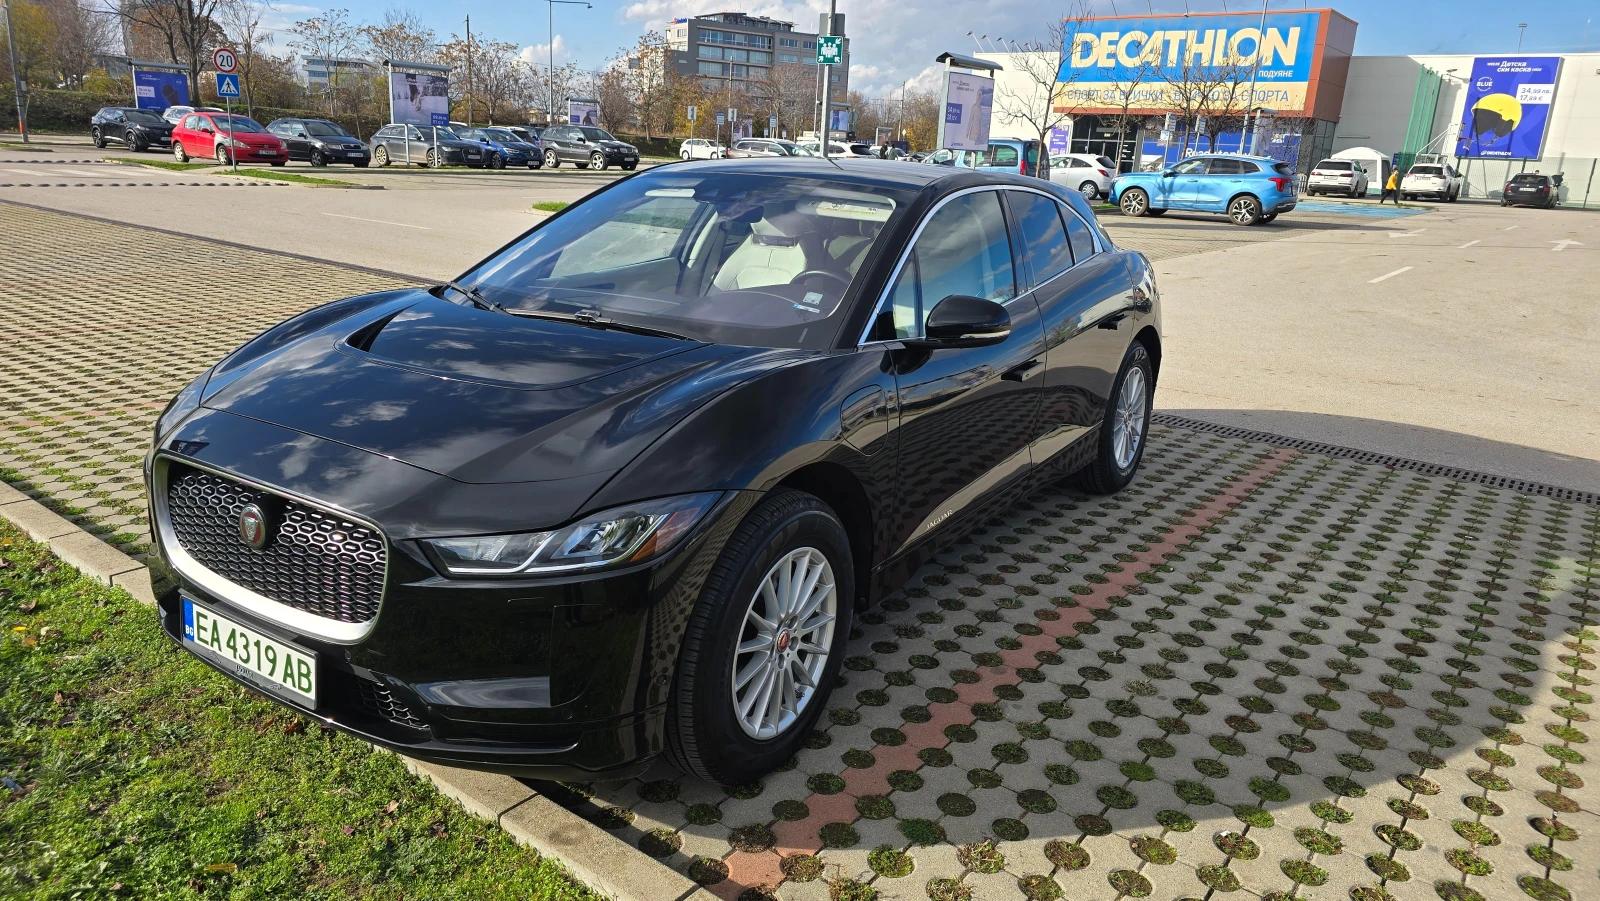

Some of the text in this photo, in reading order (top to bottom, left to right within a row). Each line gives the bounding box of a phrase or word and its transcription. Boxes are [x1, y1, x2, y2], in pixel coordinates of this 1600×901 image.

[1071, 27, 1300, 68] DECATHLON
[219, 54, 233, 67] 20
[1258, 70, 1293, 78] ПОДУЯНЕ
[1067, 89, 1101, 101] СПОРТ
[1103, 89, 1117, 101] ЗА
[1119, 89, 1164, 102] ВИЧКИ
[926, 510, 953, 529] JAGUAR
[185, 625, 194, 636] BG
[196, 611, 312, 693] EA 4319 AB
